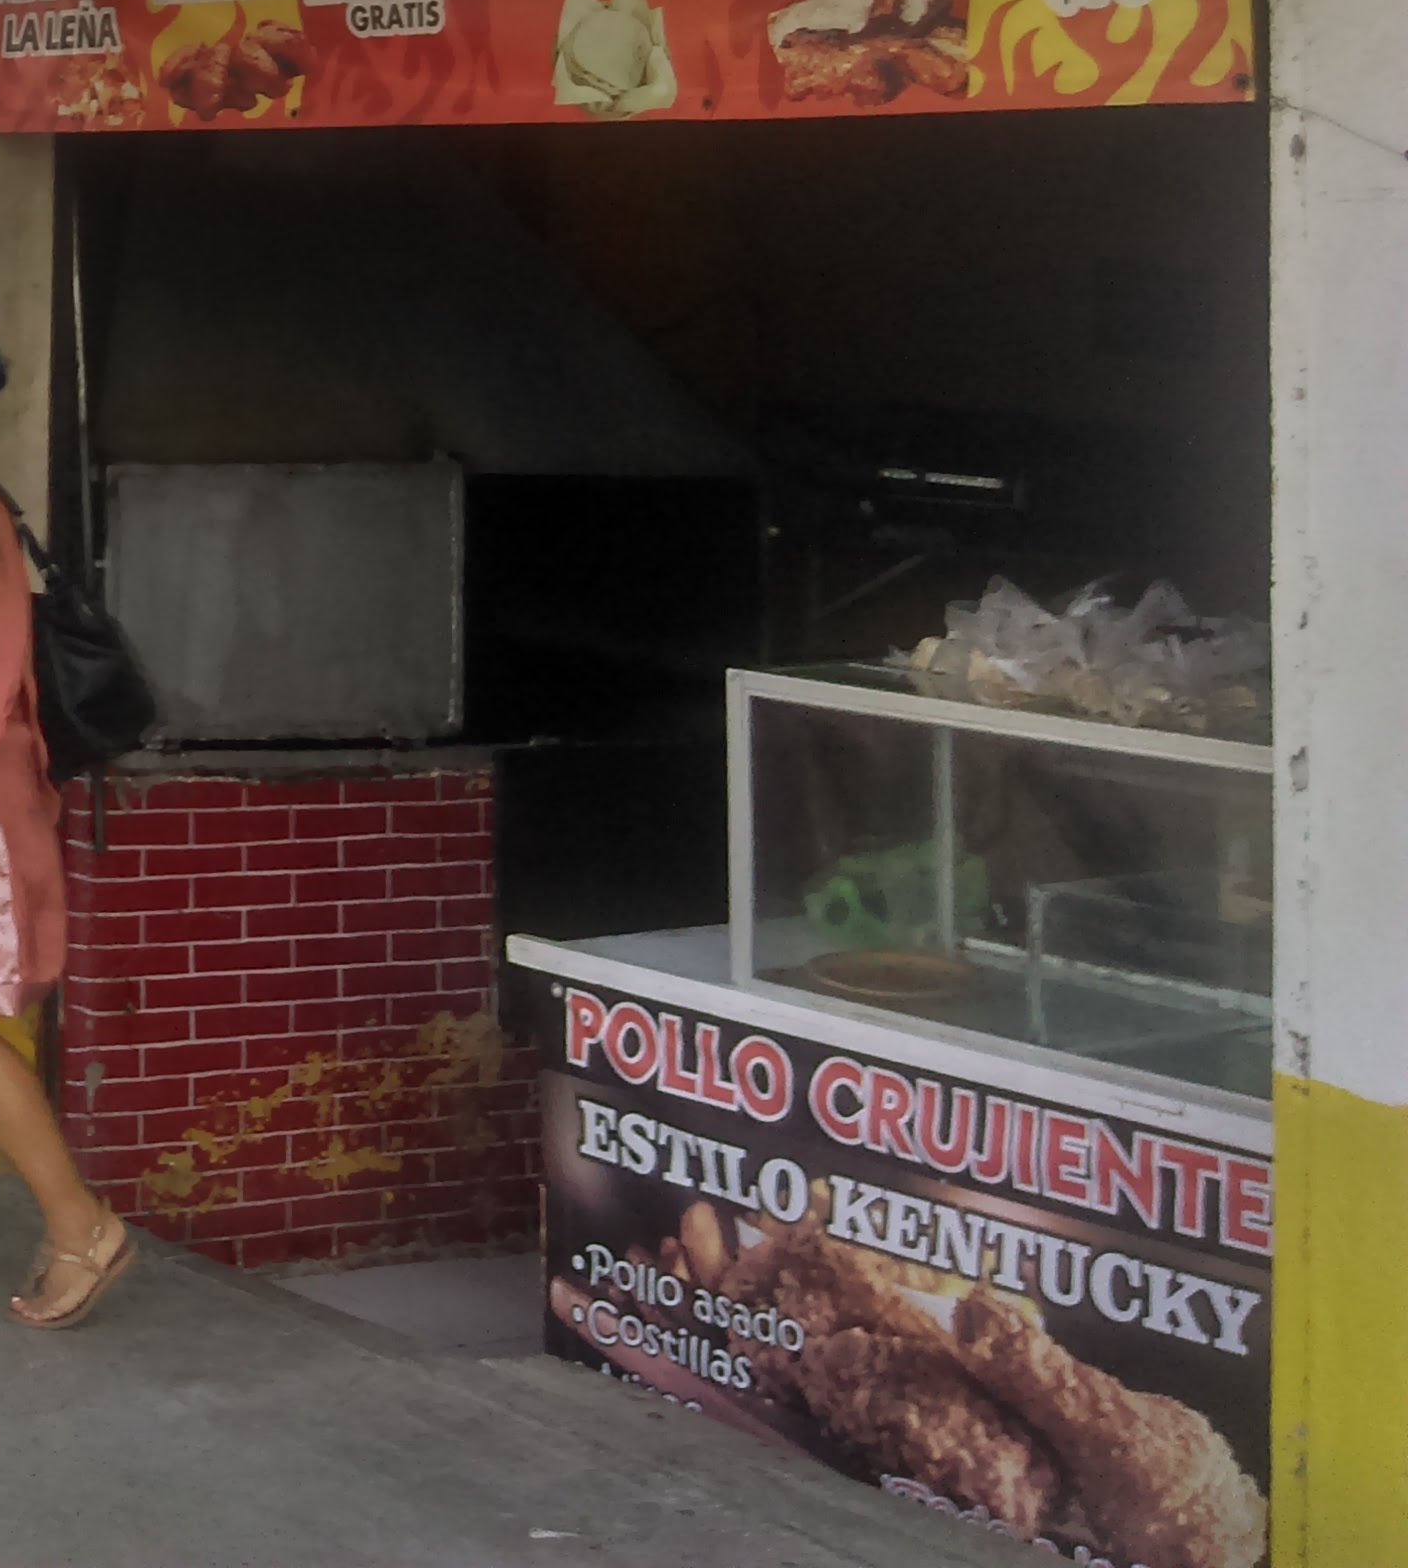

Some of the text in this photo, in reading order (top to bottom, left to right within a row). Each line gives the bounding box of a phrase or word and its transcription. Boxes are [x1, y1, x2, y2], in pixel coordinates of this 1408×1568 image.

[5, 5, 119, 53] LA LEÑA
[350, 0, 440, 31] GRATIS
[564, 986, 1273, 1257] POLLO CRUJIENTE
[578, 1099, 1262, 1357] ESTILO KENTUCKY
[585, 1243, 805, 1352] Pollo asado
[587, 1299, 753, 1390] Costillas
